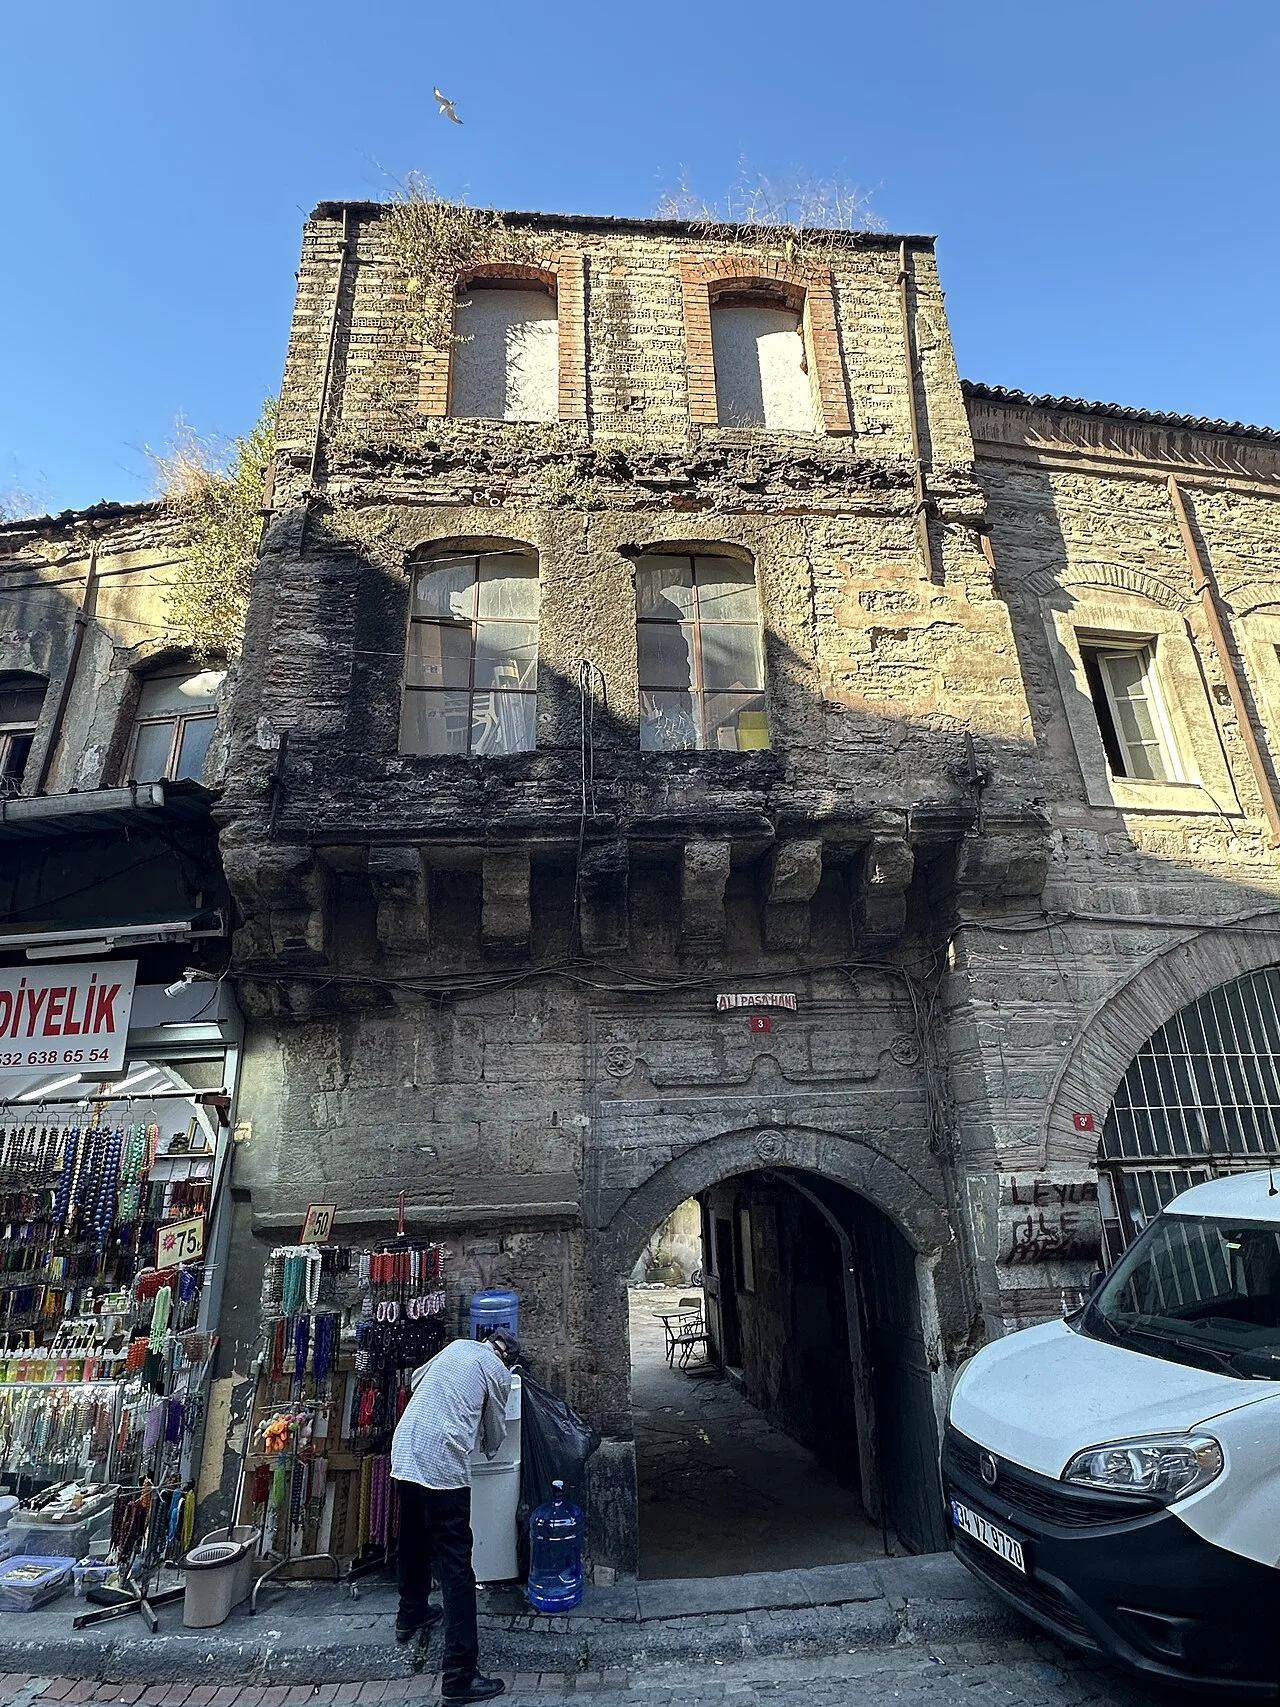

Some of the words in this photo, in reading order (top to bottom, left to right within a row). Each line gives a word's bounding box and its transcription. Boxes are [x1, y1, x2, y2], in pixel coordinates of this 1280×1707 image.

[757, 1020, 764, 1028] 3
[0, 1052, 22, 1066] 32
[28, 1050, 58, 1065] 638
[63, 1049, 84, 1063] 65
[89, 1048, 109, 1062] 54
[957, 1502, 971, 1531] 34
[973, 1513, 989, 1545] YZ
[990, 1526, 1023, 1568] 9720
